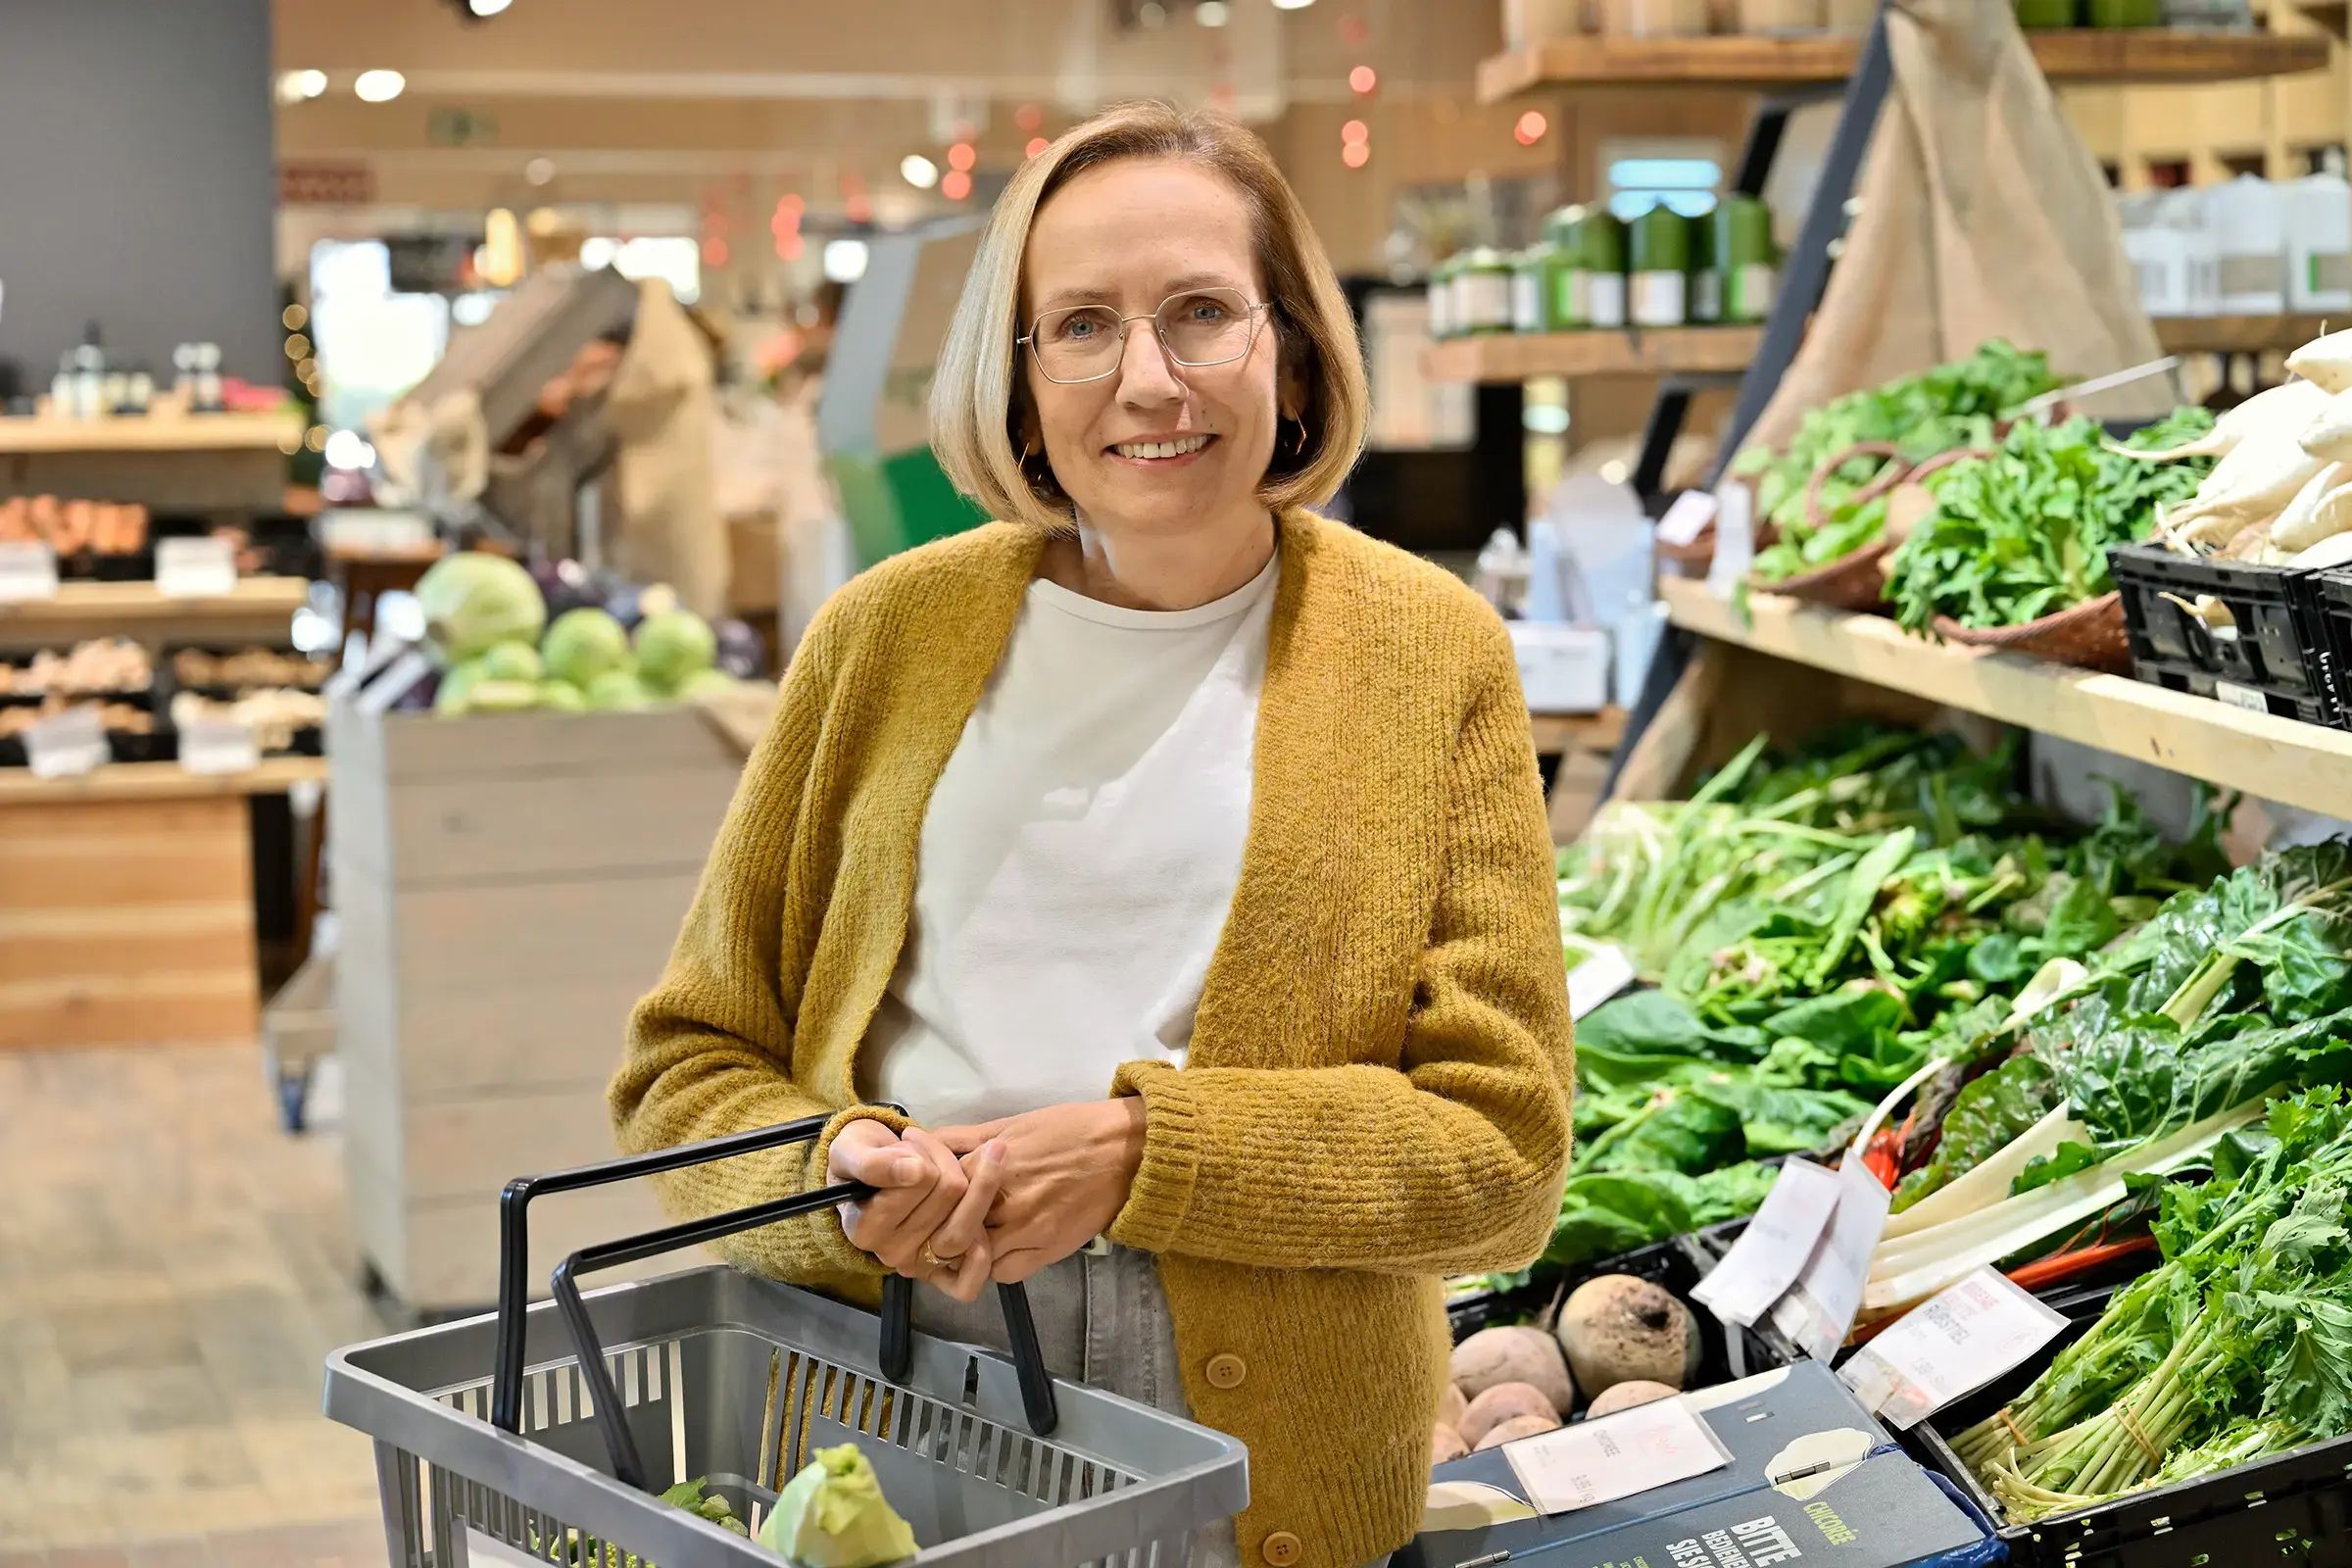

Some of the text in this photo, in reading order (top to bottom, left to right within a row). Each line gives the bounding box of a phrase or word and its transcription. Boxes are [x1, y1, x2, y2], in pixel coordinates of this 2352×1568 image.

[1730, 1515, 1802, 1568] BITTE
[1802, 1500, 1859, 1545] CHICORÉE
[1665, 1538, 1704, 1561] SIE
